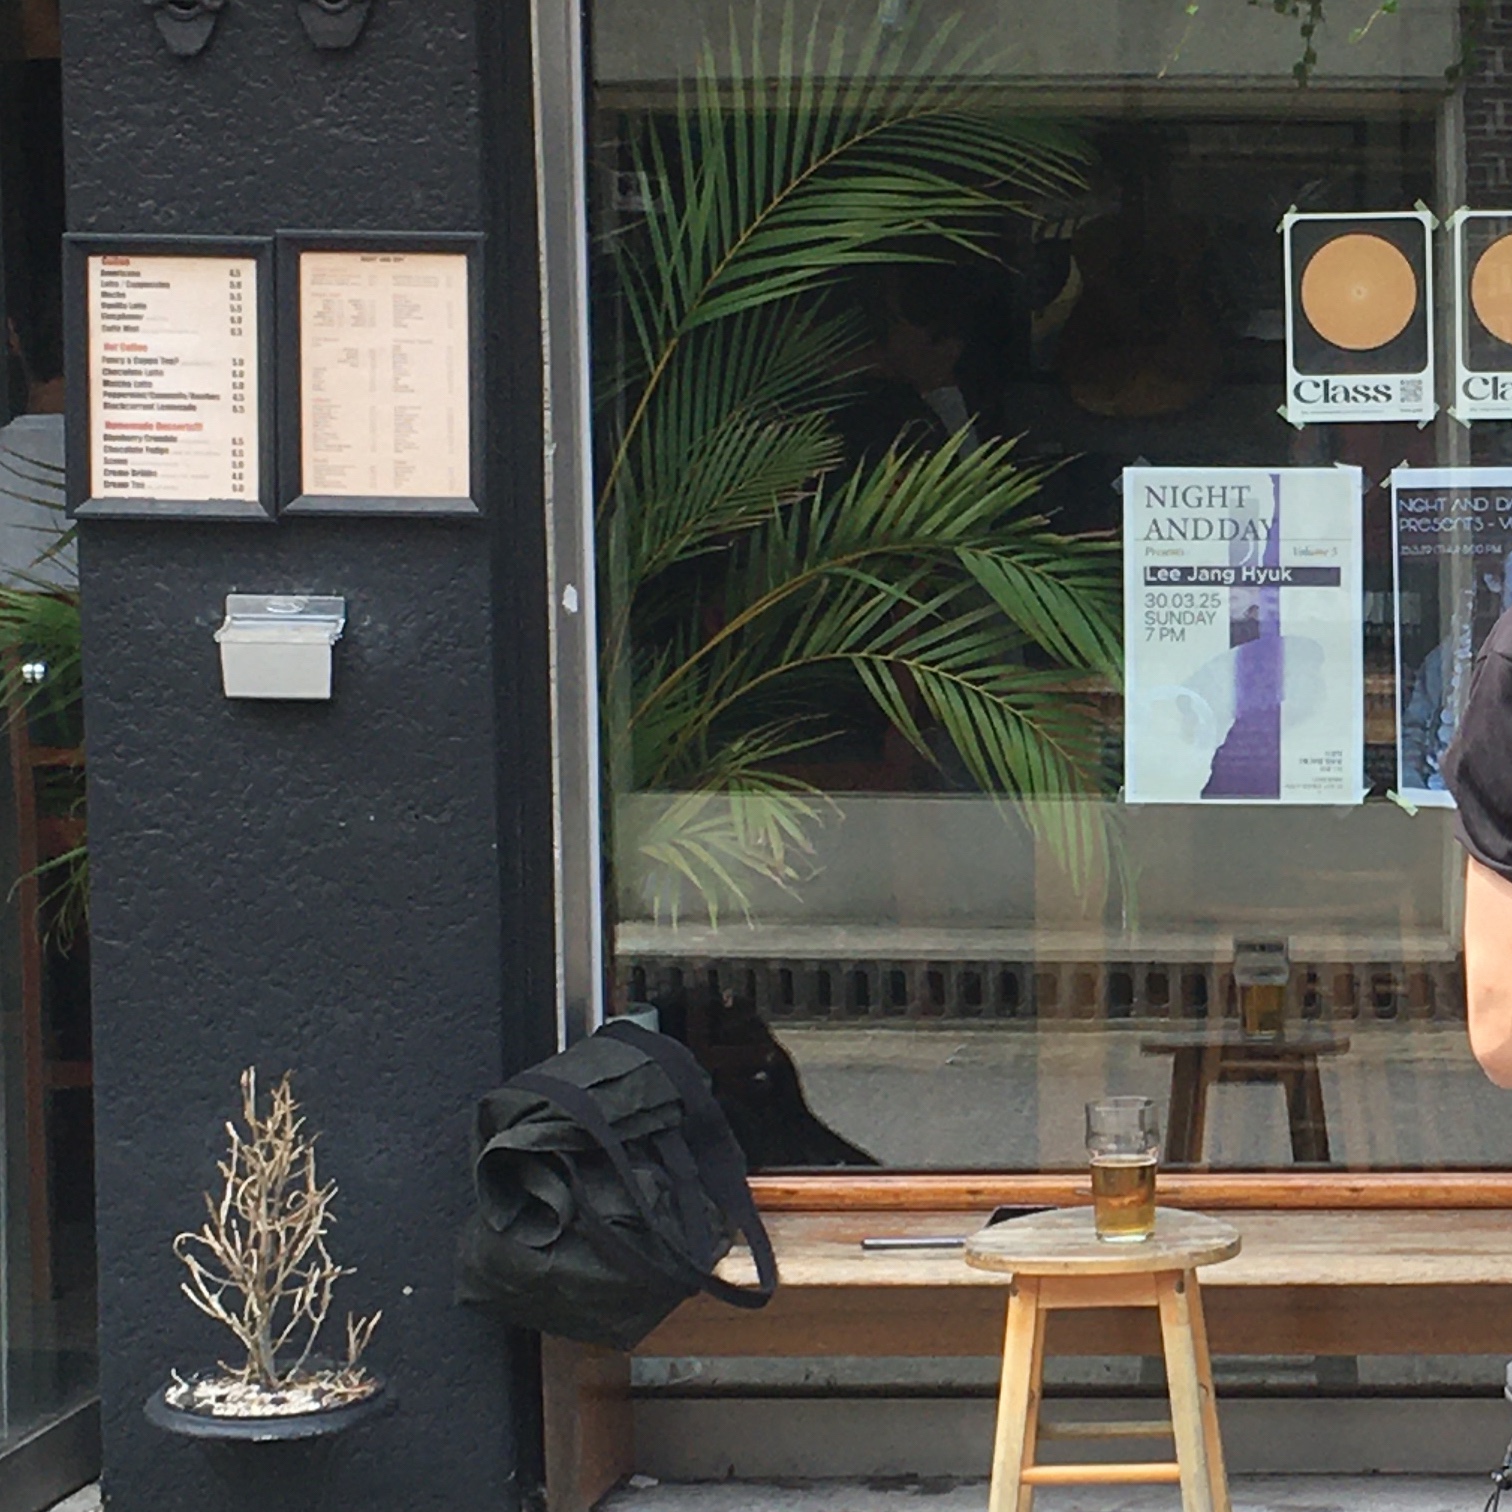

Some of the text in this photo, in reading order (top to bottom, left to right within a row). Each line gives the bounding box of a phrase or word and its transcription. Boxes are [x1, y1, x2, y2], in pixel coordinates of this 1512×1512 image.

[1293, 379, 1393, 404] Class
[1144, 485, 1251, 508] NIGHT
[1451, 497, 1489, 512] AND
[1145, 567, 1292, 584] Lee Jang Hyuk
[1144, 610, 1216, 625] SUNDAY
[1145, 627, 1186, 642] 7 PM
